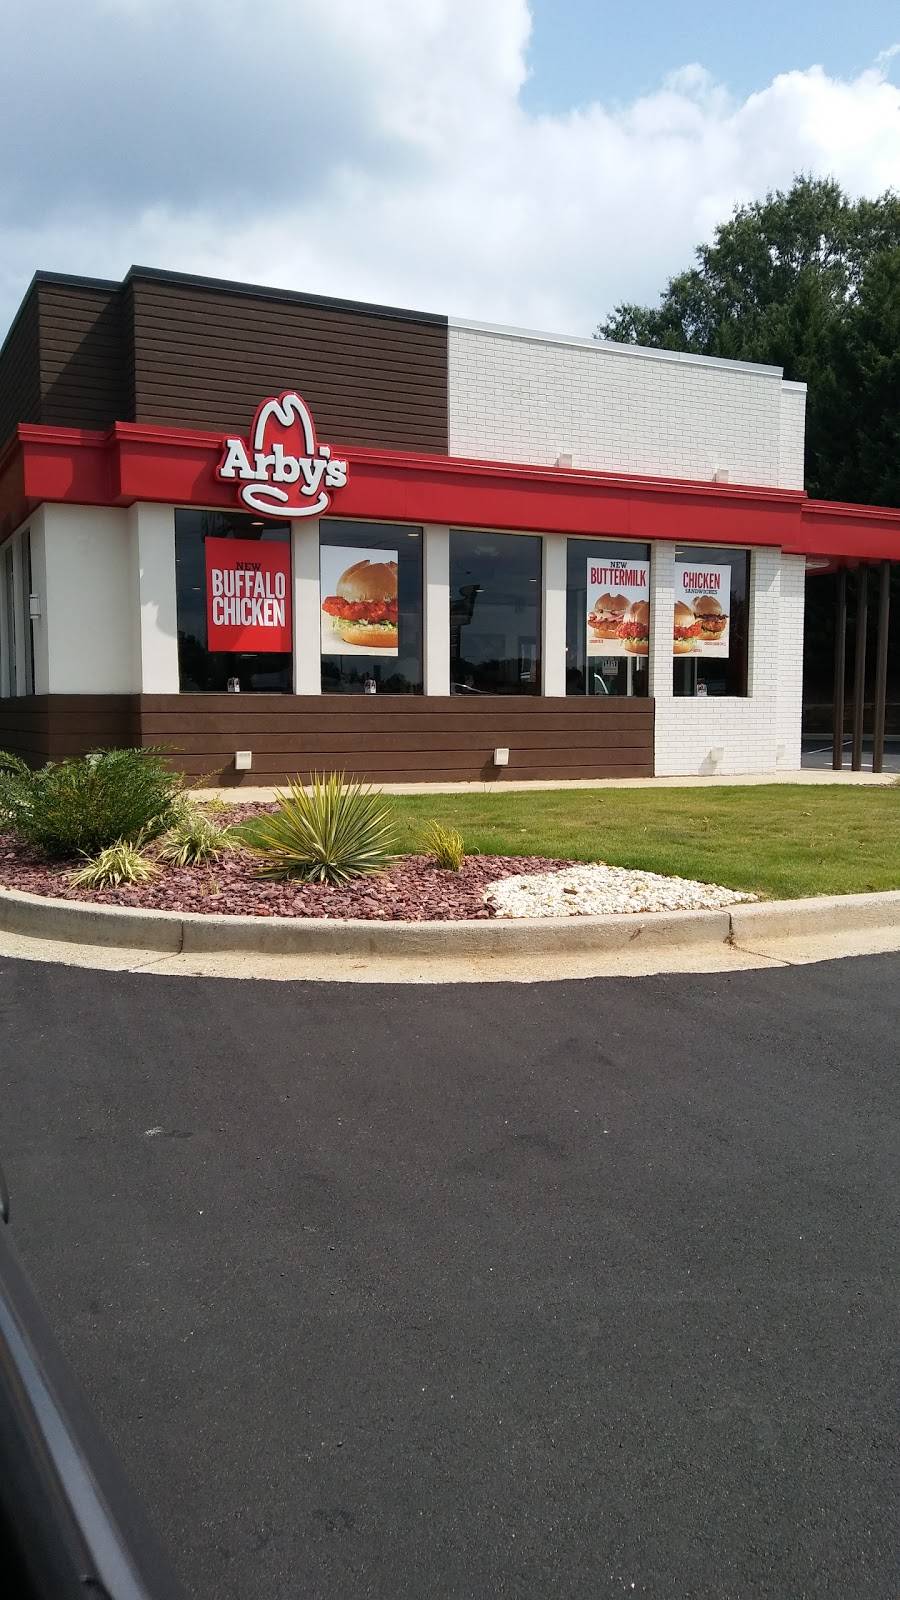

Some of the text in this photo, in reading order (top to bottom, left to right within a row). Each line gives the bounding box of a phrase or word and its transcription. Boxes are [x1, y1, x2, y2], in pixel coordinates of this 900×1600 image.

[220, 439, 347, 496] Arby's
[236, 561, 261, 570] NEW
[591, 567, 646, 587] BUTTERMILK
[211, 568, 286, 599] BUFFALO
[683, 571, 721, 589] CHICKEN
[212, 596, 286, 627] CHICKEN
